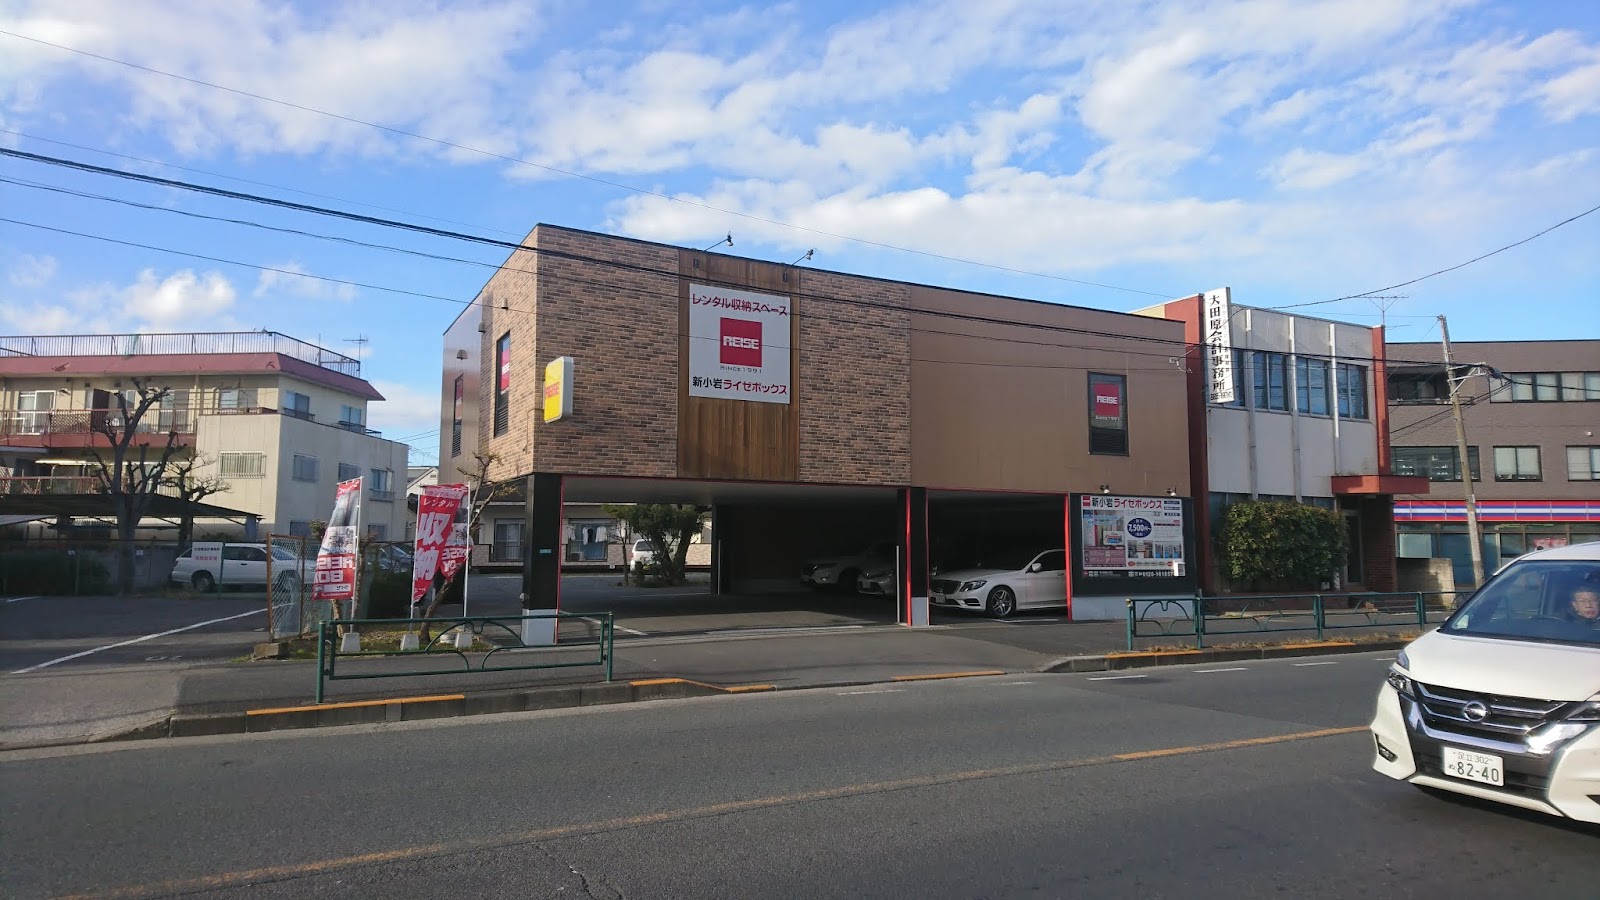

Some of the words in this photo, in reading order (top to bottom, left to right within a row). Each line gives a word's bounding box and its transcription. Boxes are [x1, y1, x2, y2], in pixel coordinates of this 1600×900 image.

[692, 294, 787, 316] レンタル収納スペース
[723, 336, 760, 350] REISE
[1209, 295, 1225, 391] 大田原会計事務所
[692, 376, 787, 395] 新小岩ライゼボックス
[1096, 395, 1118, 405] REISE
[423, 498, 454, 508] レンタル
[1092, 497, 1162, 509] 新小岩ライゼボックス
[1475, 755, 1490, 765] 302
[1457, 761, 1499, 782] 82-40
